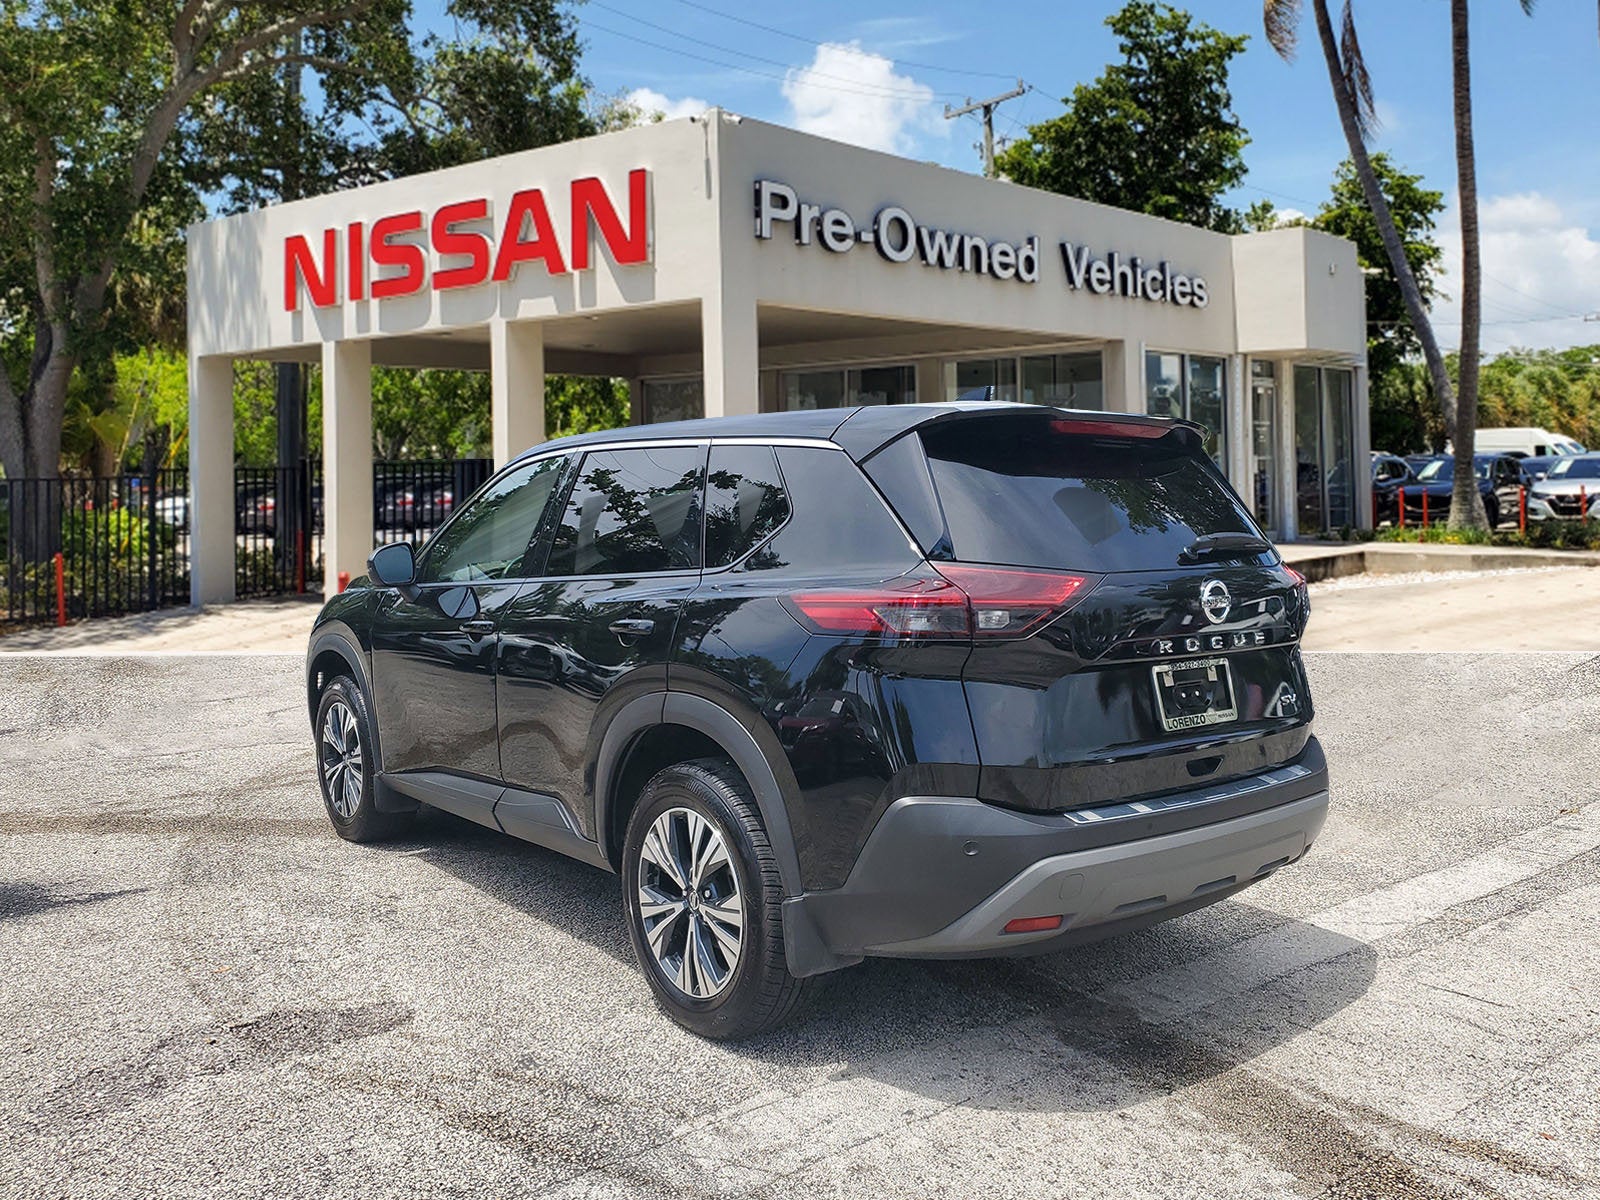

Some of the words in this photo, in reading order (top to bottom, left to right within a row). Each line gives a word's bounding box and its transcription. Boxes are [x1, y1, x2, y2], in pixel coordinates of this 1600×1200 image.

[285, 170, 648, 311] NISSAN
[754, 179, 1040, 283] Pre-Owned
[1059, 242, 1209, 308] Vehicles
[1159, 632, 1265, 654] ROGUE
[1280, 693, 1297, 706] SV
[1167, 714, 1206, 730] LORENZO
